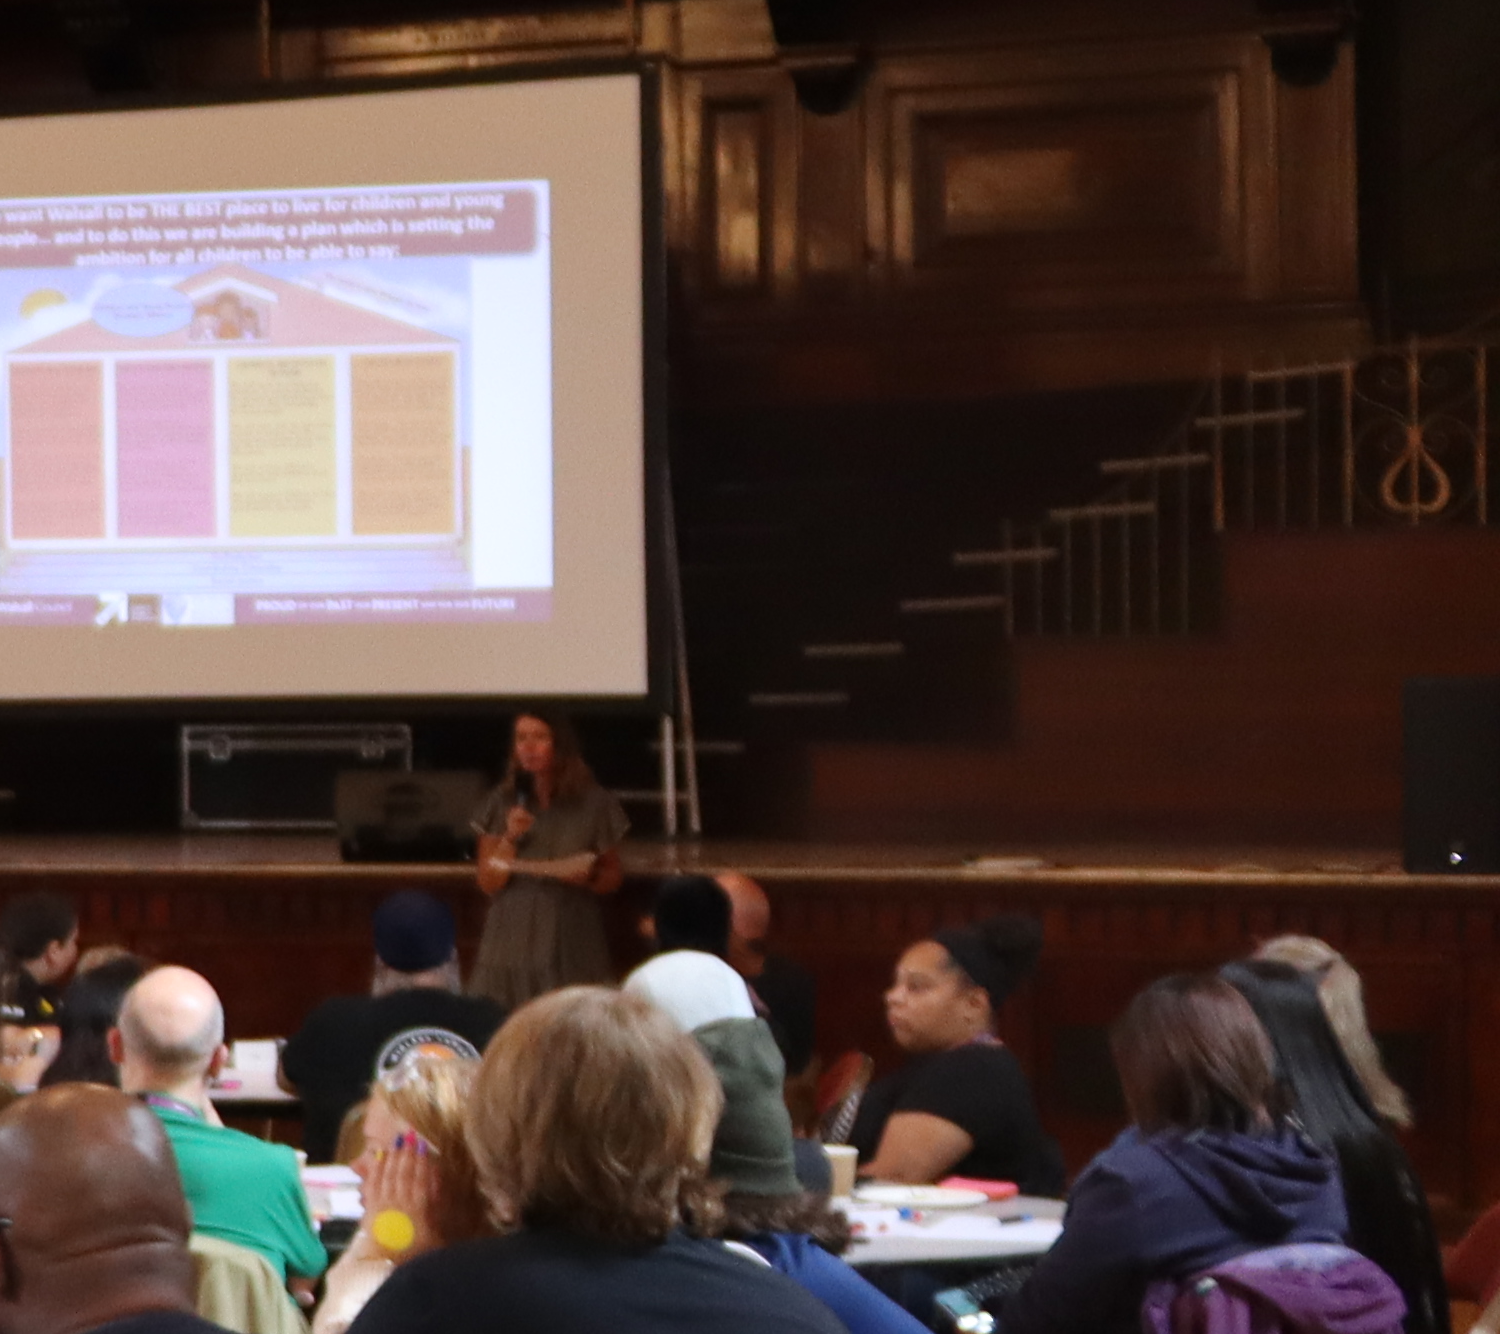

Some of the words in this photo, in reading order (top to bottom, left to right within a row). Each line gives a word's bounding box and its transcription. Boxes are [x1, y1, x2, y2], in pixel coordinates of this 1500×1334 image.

[4, 208, 43, 222] want
[48, 205, 103, 221] Walsall
[106, 206, 124, 220] to
[127, 204, 148, 219] be
[152, 203, 179, 218] THE
[184, 202, 221, 218] BEST
[225, 200, 268, 220] place
[271, 200, 289, 215] to
[292, 198, 320, 214] live
[324, 197, 347, 213] for
[350, 193, 416, 211] children
[420, 192, 450, 208] and
[454, 193, 505, 211] young
[54, 228, 85, 244] and
[87, 228, 105, 243] to
[107, 227, 129, 243] do
[131, 226, 161, 242] this
[163, 228, 188, 242] we
[191, 227, 218, 241] are
[221, 222, 285, 241] building
[288, 224, 299, 238] a
[302, 221, 337, 240] plan
[340, 218, 388, 236] which
[392, 217, 405, 233] is
[408, 216, 463, 235] setting
[467, 214, 495, 231] the
[75, 250, 147, 267] ambition
[149, 249, 171, 266] for
[175, 248, 195, 264] all
[197, 245, 262, 264] children
[265, 246, 282, 261] to
[285, 244, 305, 260] be
[309, 242, 345, 259] able
[348, 242, 366, 258] to
